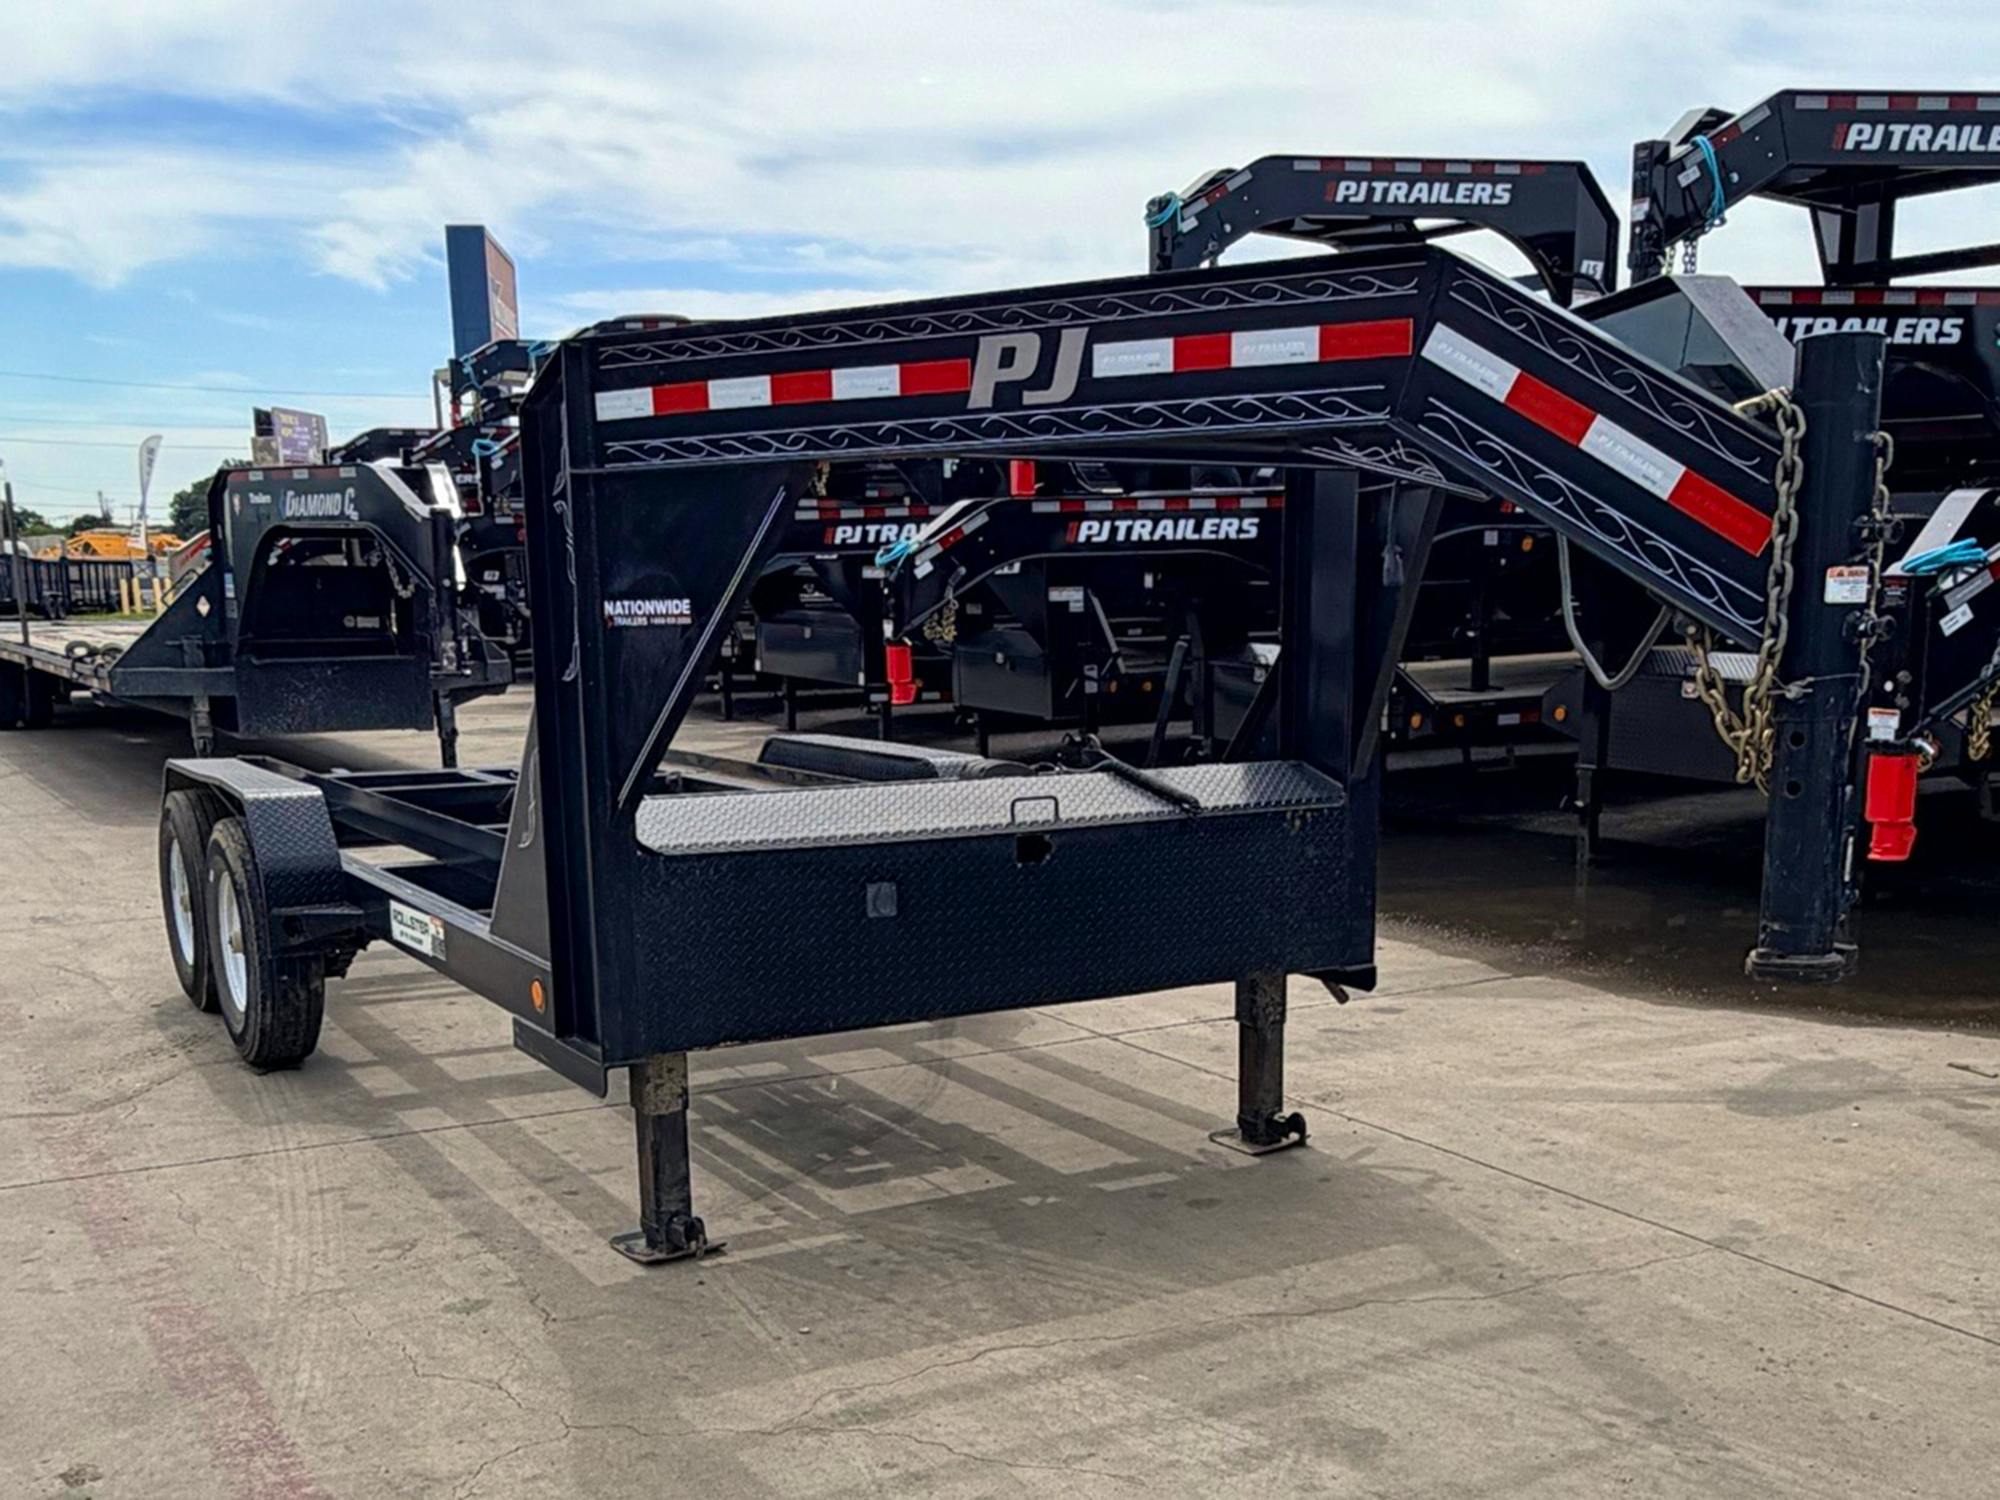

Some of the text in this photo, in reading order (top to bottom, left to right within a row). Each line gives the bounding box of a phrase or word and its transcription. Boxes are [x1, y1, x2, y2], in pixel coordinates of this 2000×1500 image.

[1844, 123, 1885, 150] PJ
[1335, 181, 1512, 204] PJ TRAILERS
[967, 327, 1089, 409] PJ
[834, 525, 862, 544] PJ
[1077, 518, 1259, 543] PJ TRAILERS
[604, 598, 691, 616] NATIONWIDE
